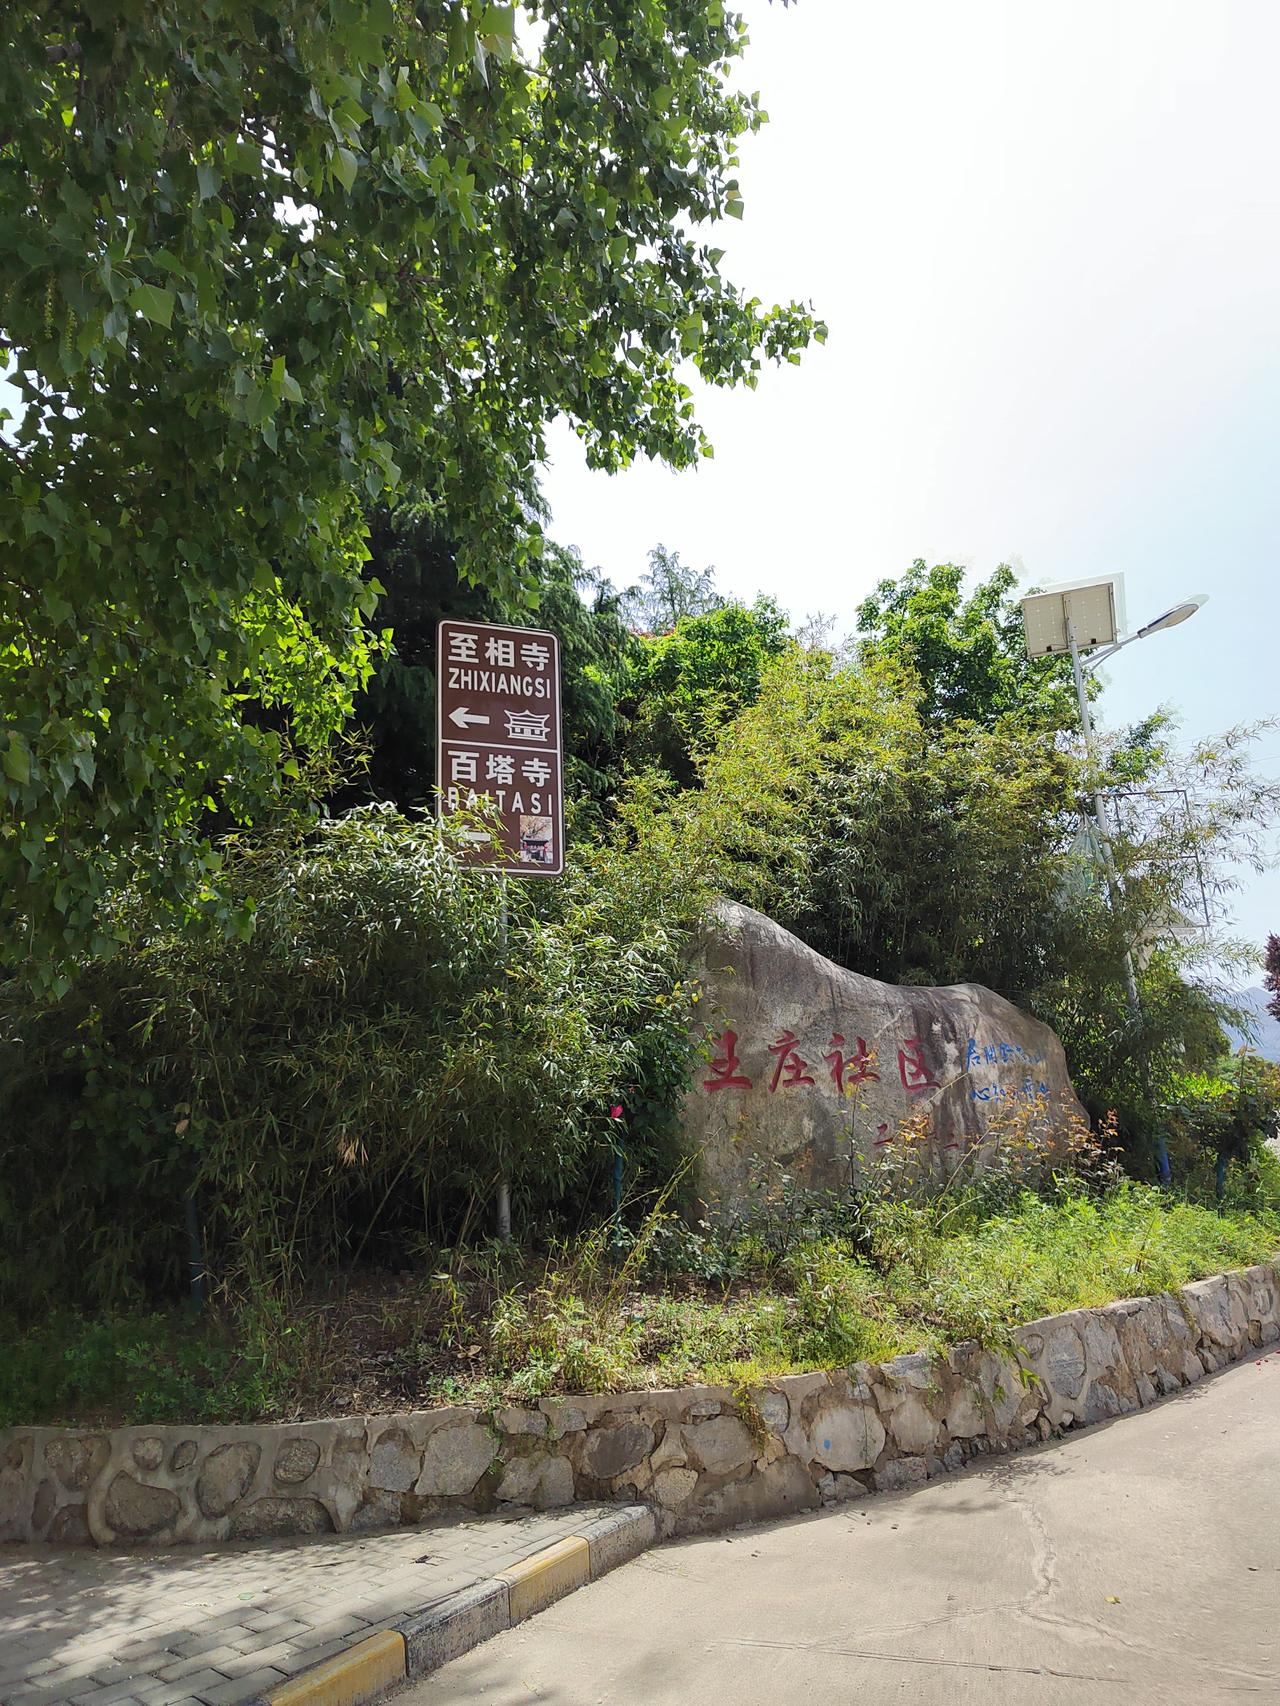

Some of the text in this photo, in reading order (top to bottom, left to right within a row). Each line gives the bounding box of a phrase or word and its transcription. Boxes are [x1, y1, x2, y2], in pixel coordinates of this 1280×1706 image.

[448, 631, 550, 671] 至相寺
[448, 667, 551, 699] ZHIXIANGSI
[448, 750, 552, 787] 百塔寺
[703, 1029, 941, 1093] 王庄社区
